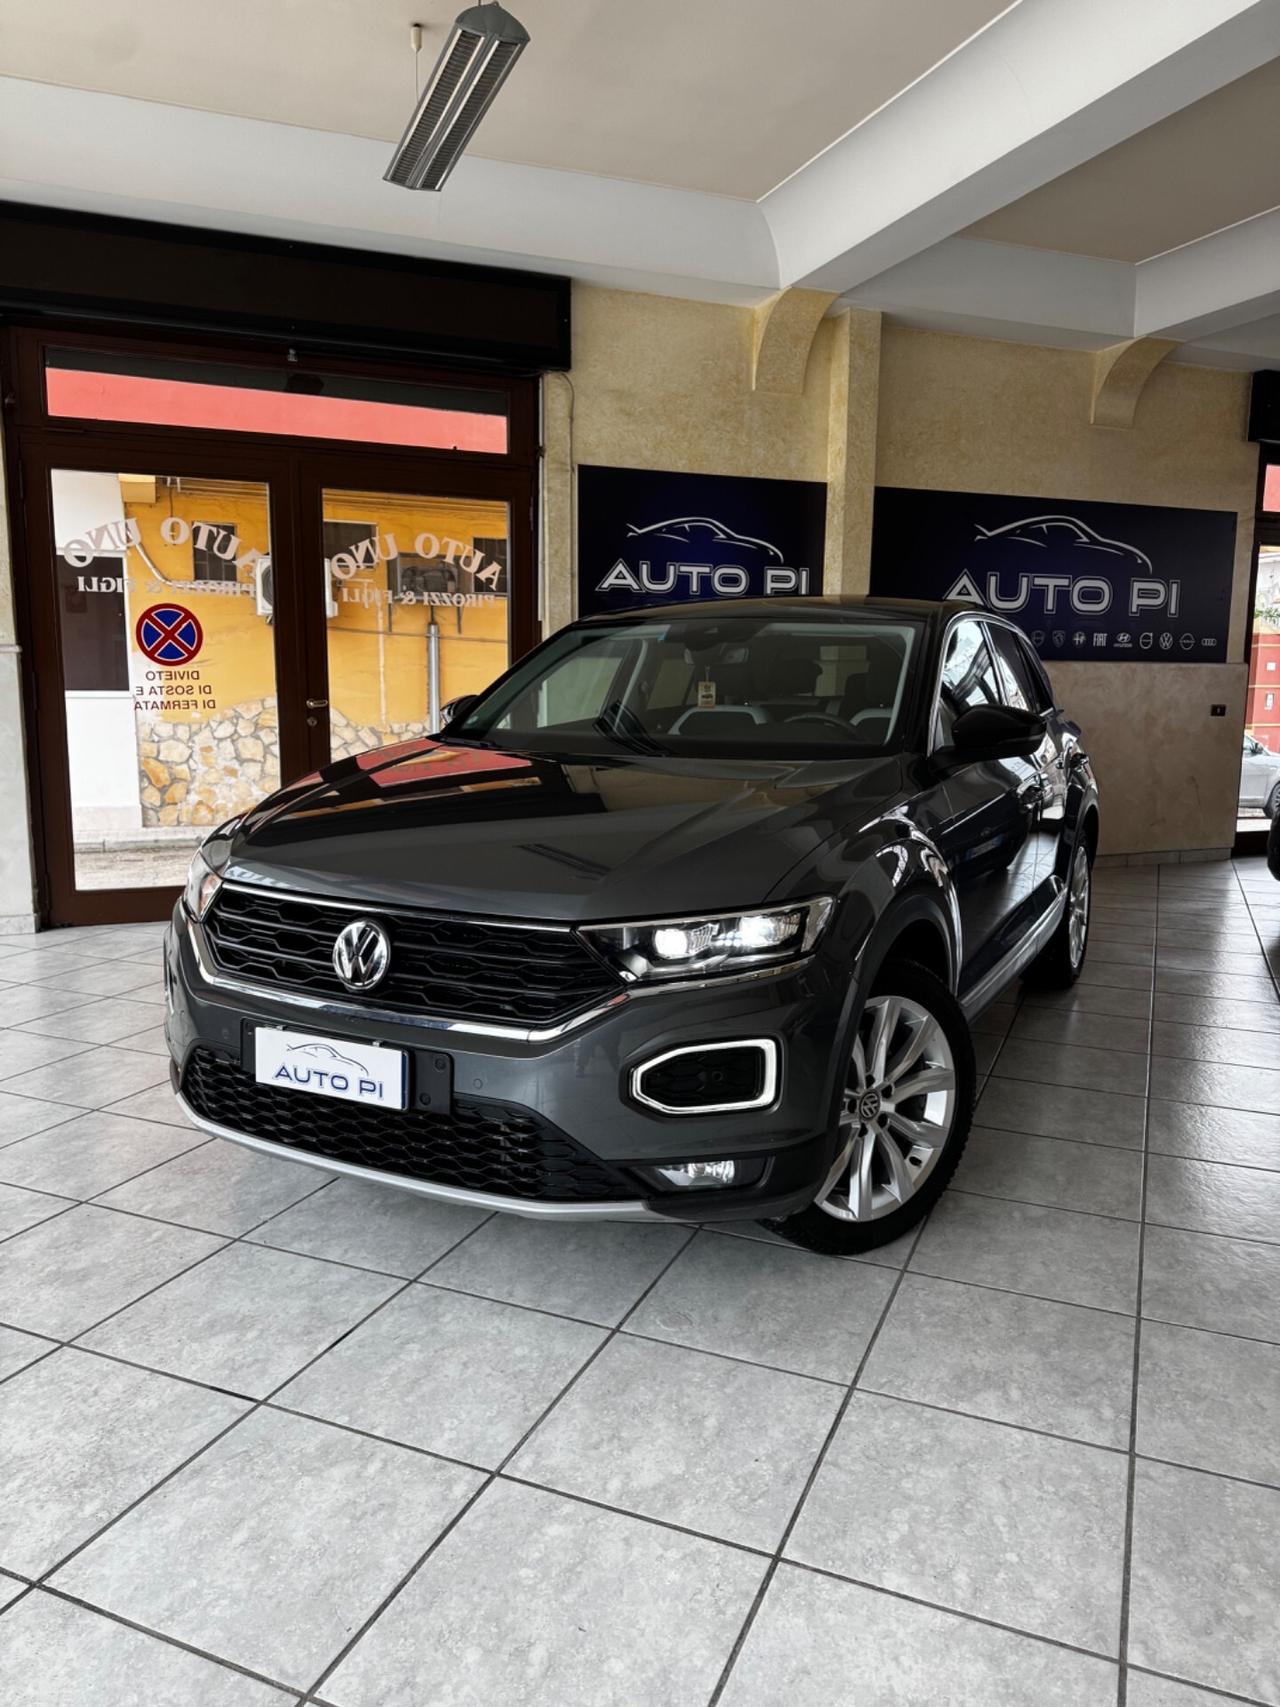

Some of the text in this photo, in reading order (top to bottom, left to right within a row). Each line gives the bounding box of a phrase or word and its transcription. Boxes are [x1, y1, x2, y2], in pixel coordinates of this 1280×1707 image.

[595, 558, 809, 597] AUTO PI
[942, 568, 1180, 617] AUTO PI
[273, 1063, 384, 1099] AUTO PI
